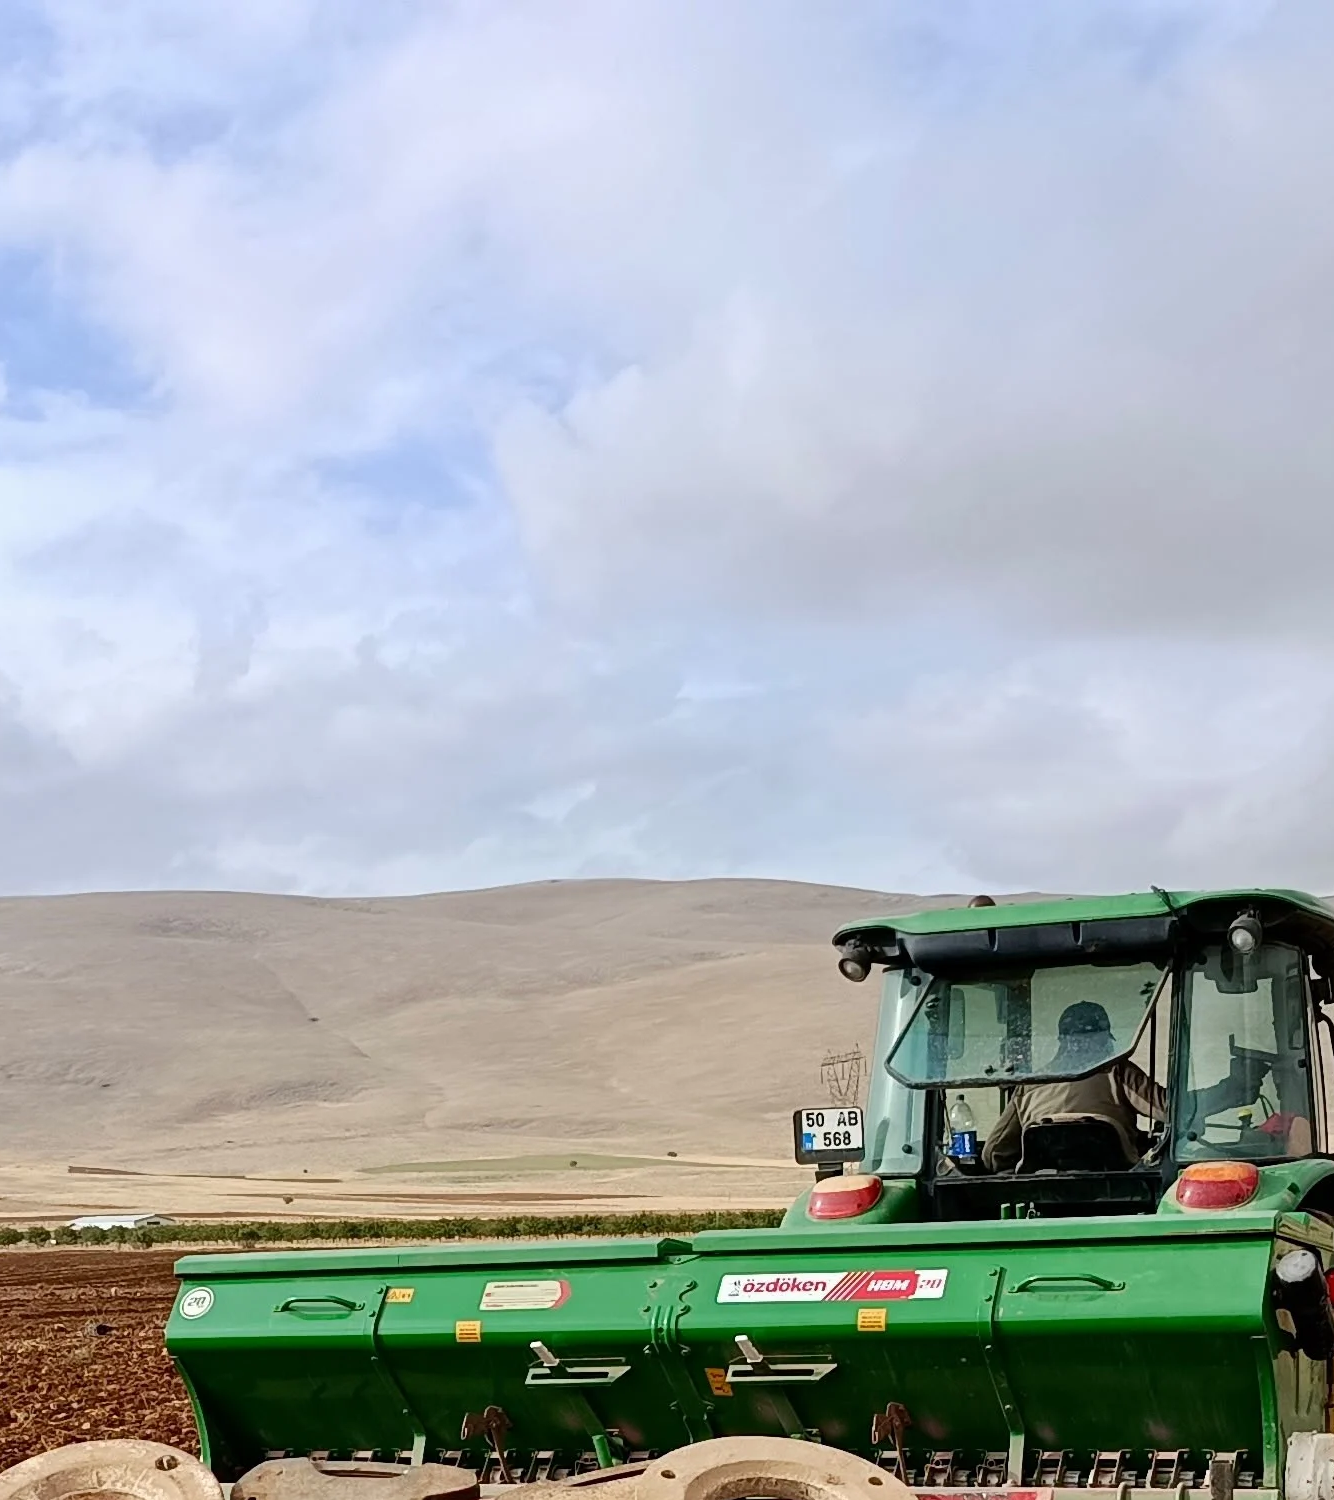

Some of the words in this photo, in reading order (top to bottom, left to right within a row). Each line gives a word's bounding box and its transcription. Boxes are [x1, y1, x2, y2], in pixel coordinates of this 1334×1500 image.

[805, 1112, 825, 1127] 50
[837, 1111, 859, 1126] AB
[823, 1131, 851, 1148] 568
[742, 1277, 827, 1293] özdöken
